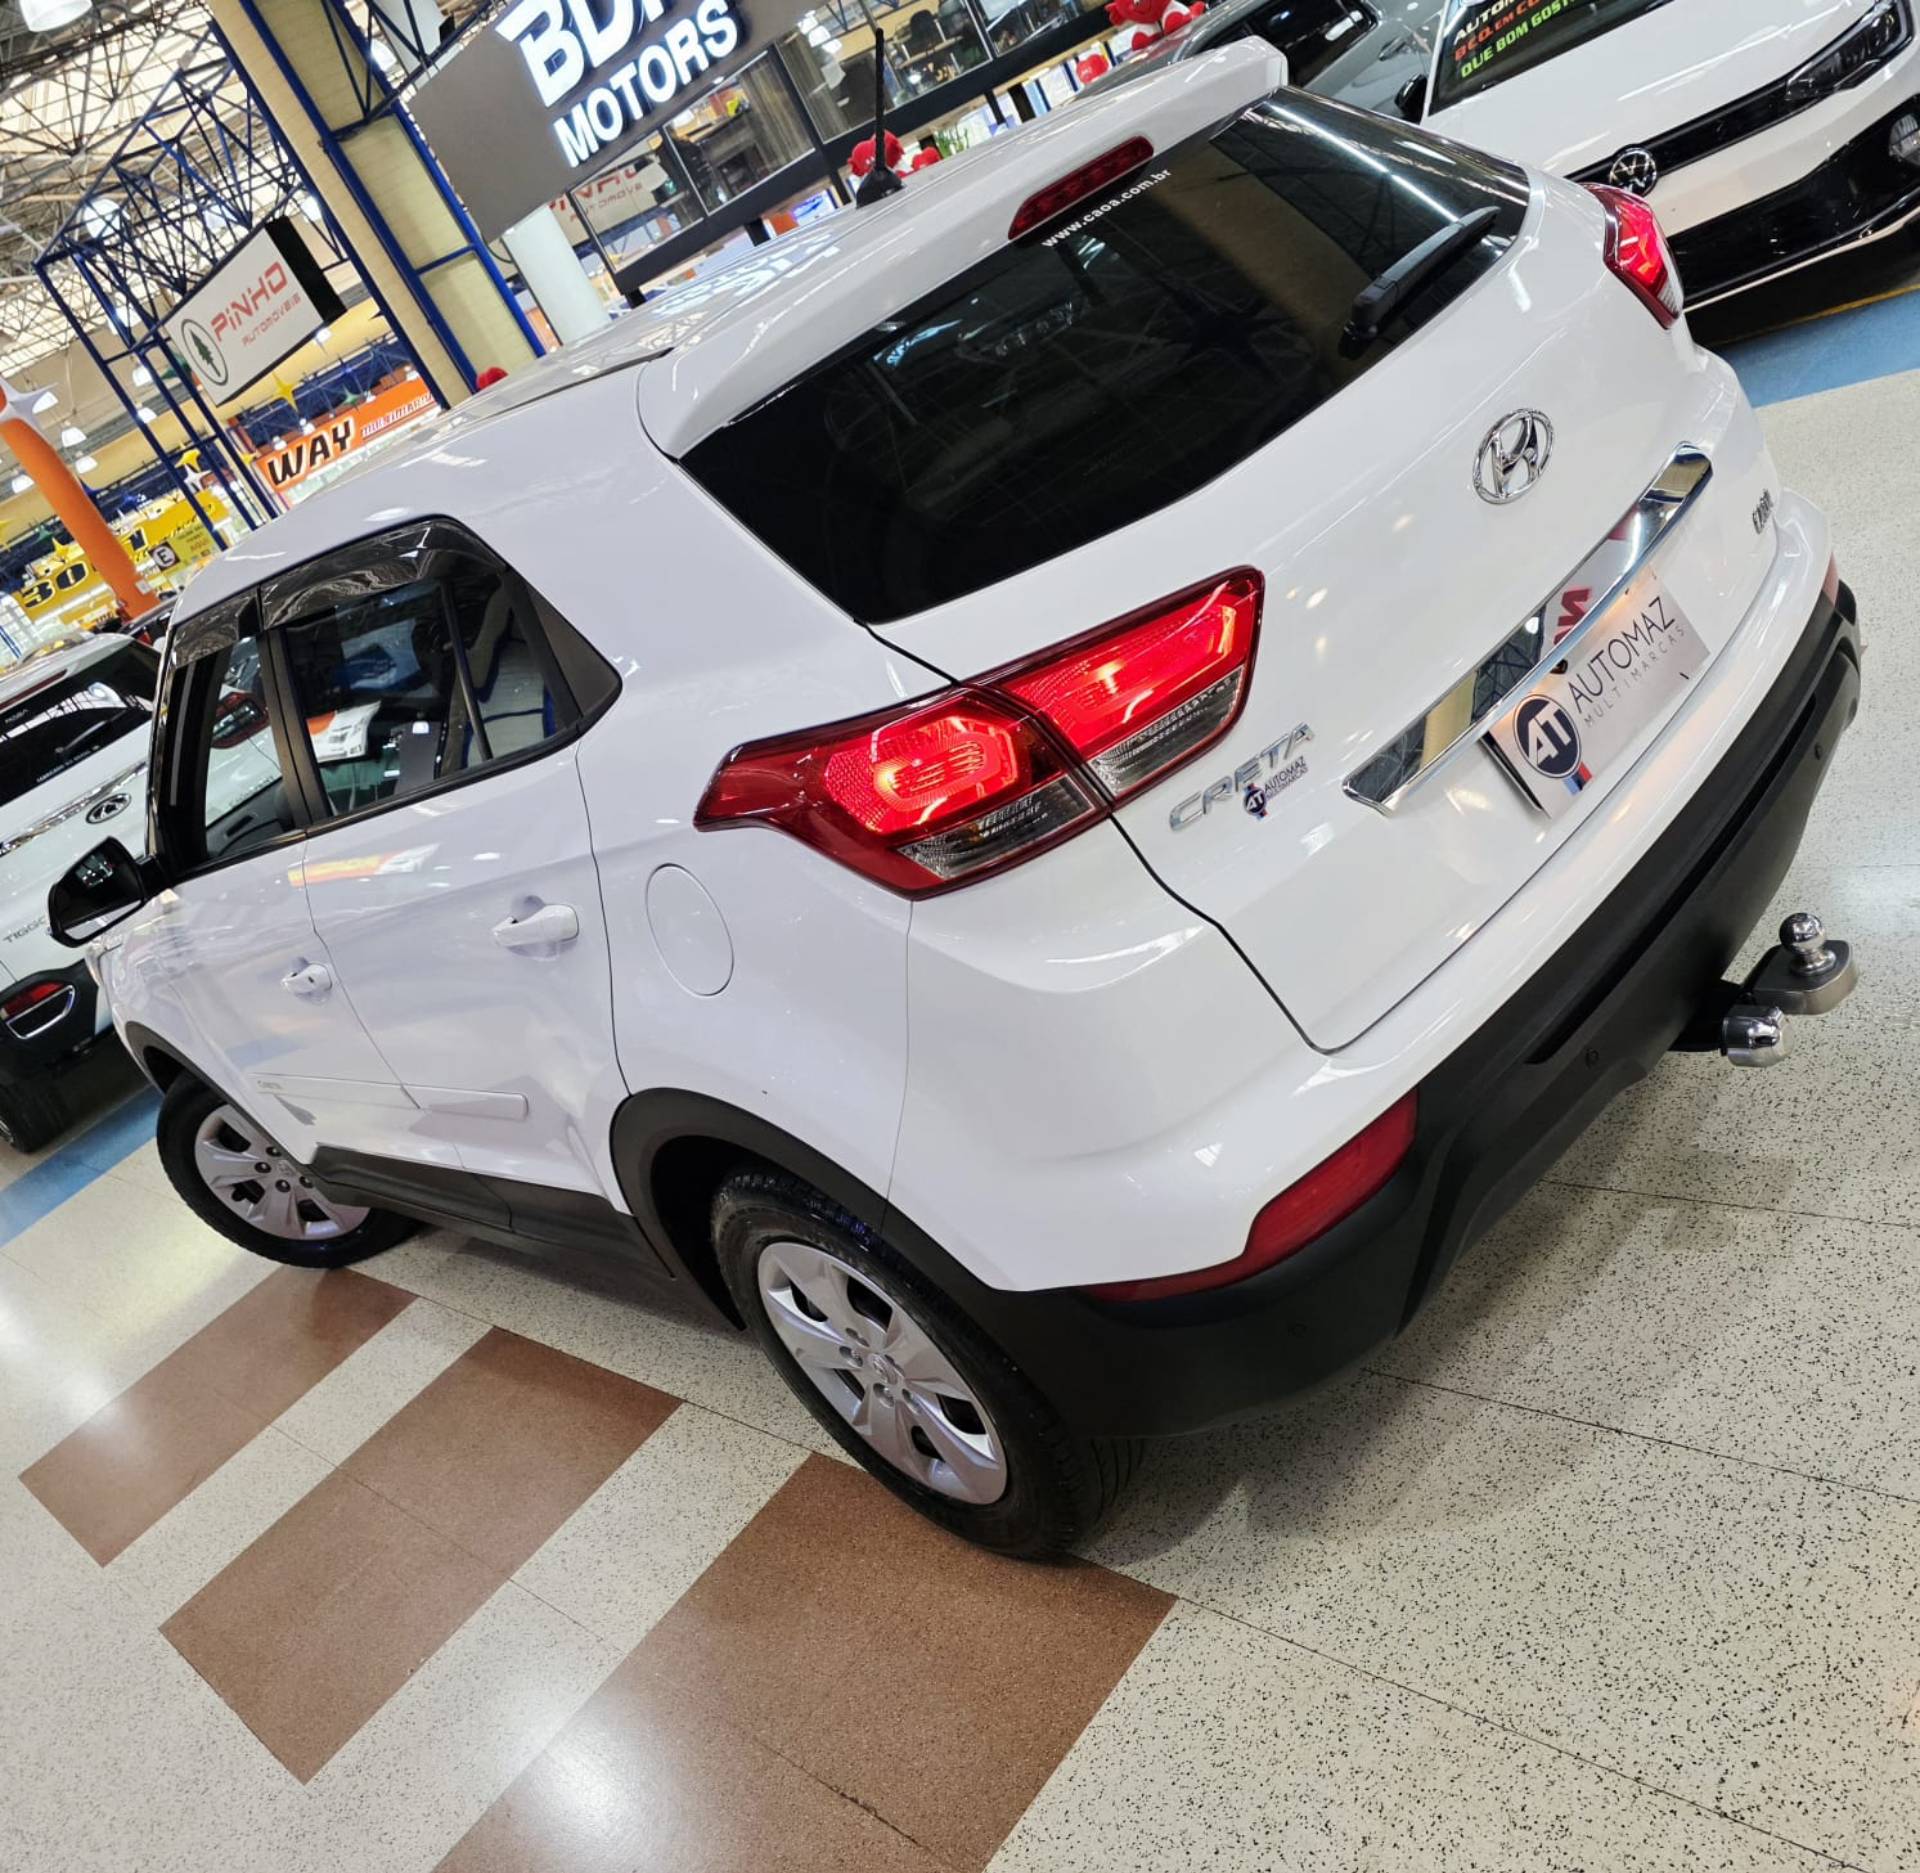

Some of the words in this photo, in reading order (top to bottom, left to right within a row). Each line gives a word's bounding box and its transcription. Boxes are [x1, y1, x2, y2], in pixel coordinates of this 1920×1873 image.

[1460, 47, 1494, 78] QUE
[1496, 21, 1529, 52] BOM
[1531, 0, 1575, 28] GOST
[552, 0, 738, 168] MOTORS
[1041, 169, 1172, 247] www.caoa.com.br
[267, 419, 353, 487] WAY
[1567, 595, 1676, 714] AUTOMAZ
[1583, 625, 1687, 728] MULTIMARCAS
[1527, 701, 1573, 766] AT
[1169, 722, 1314, 831] CRETA
[1263, 755, 1307, 793] AUTOMAZ
